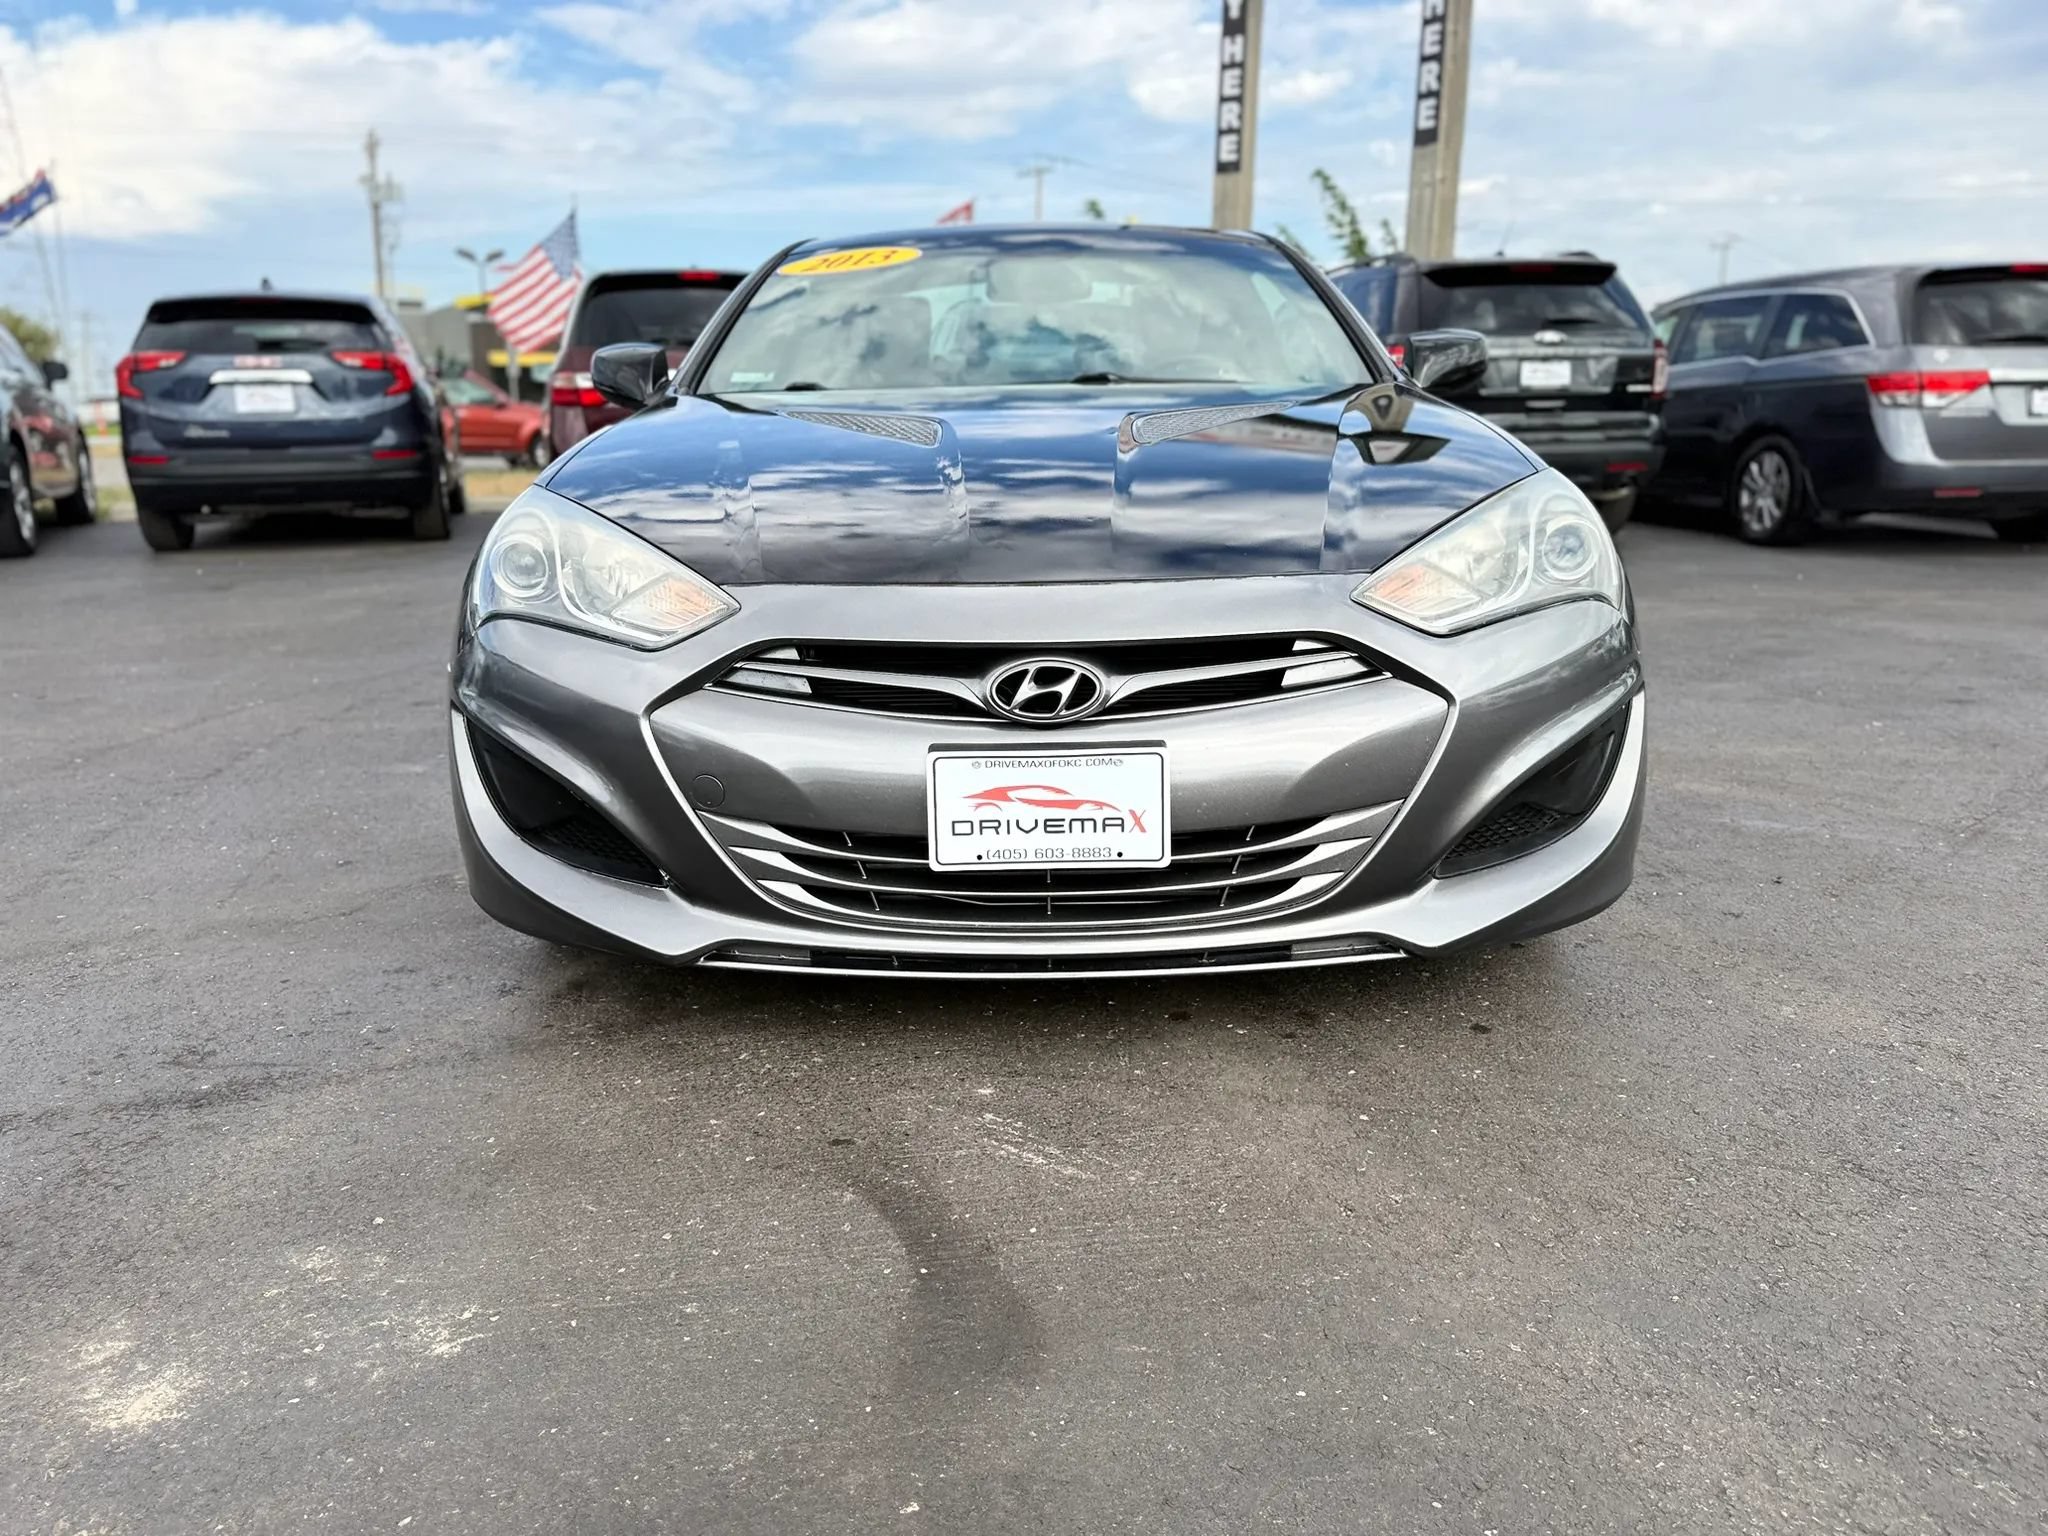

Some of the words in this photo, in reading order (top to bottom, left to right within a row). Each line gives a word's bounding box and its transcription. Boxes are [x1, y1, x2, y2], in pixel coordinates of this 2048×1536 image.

[1218, 33, 1245, 163] HERE
[800, 249, 899, 272] 2013
[951, 809, 1147, 836] DRIVEMAX
[986, 848, 1028, 860] (405)
[1034, 847, 1112, 859] 603-8883
